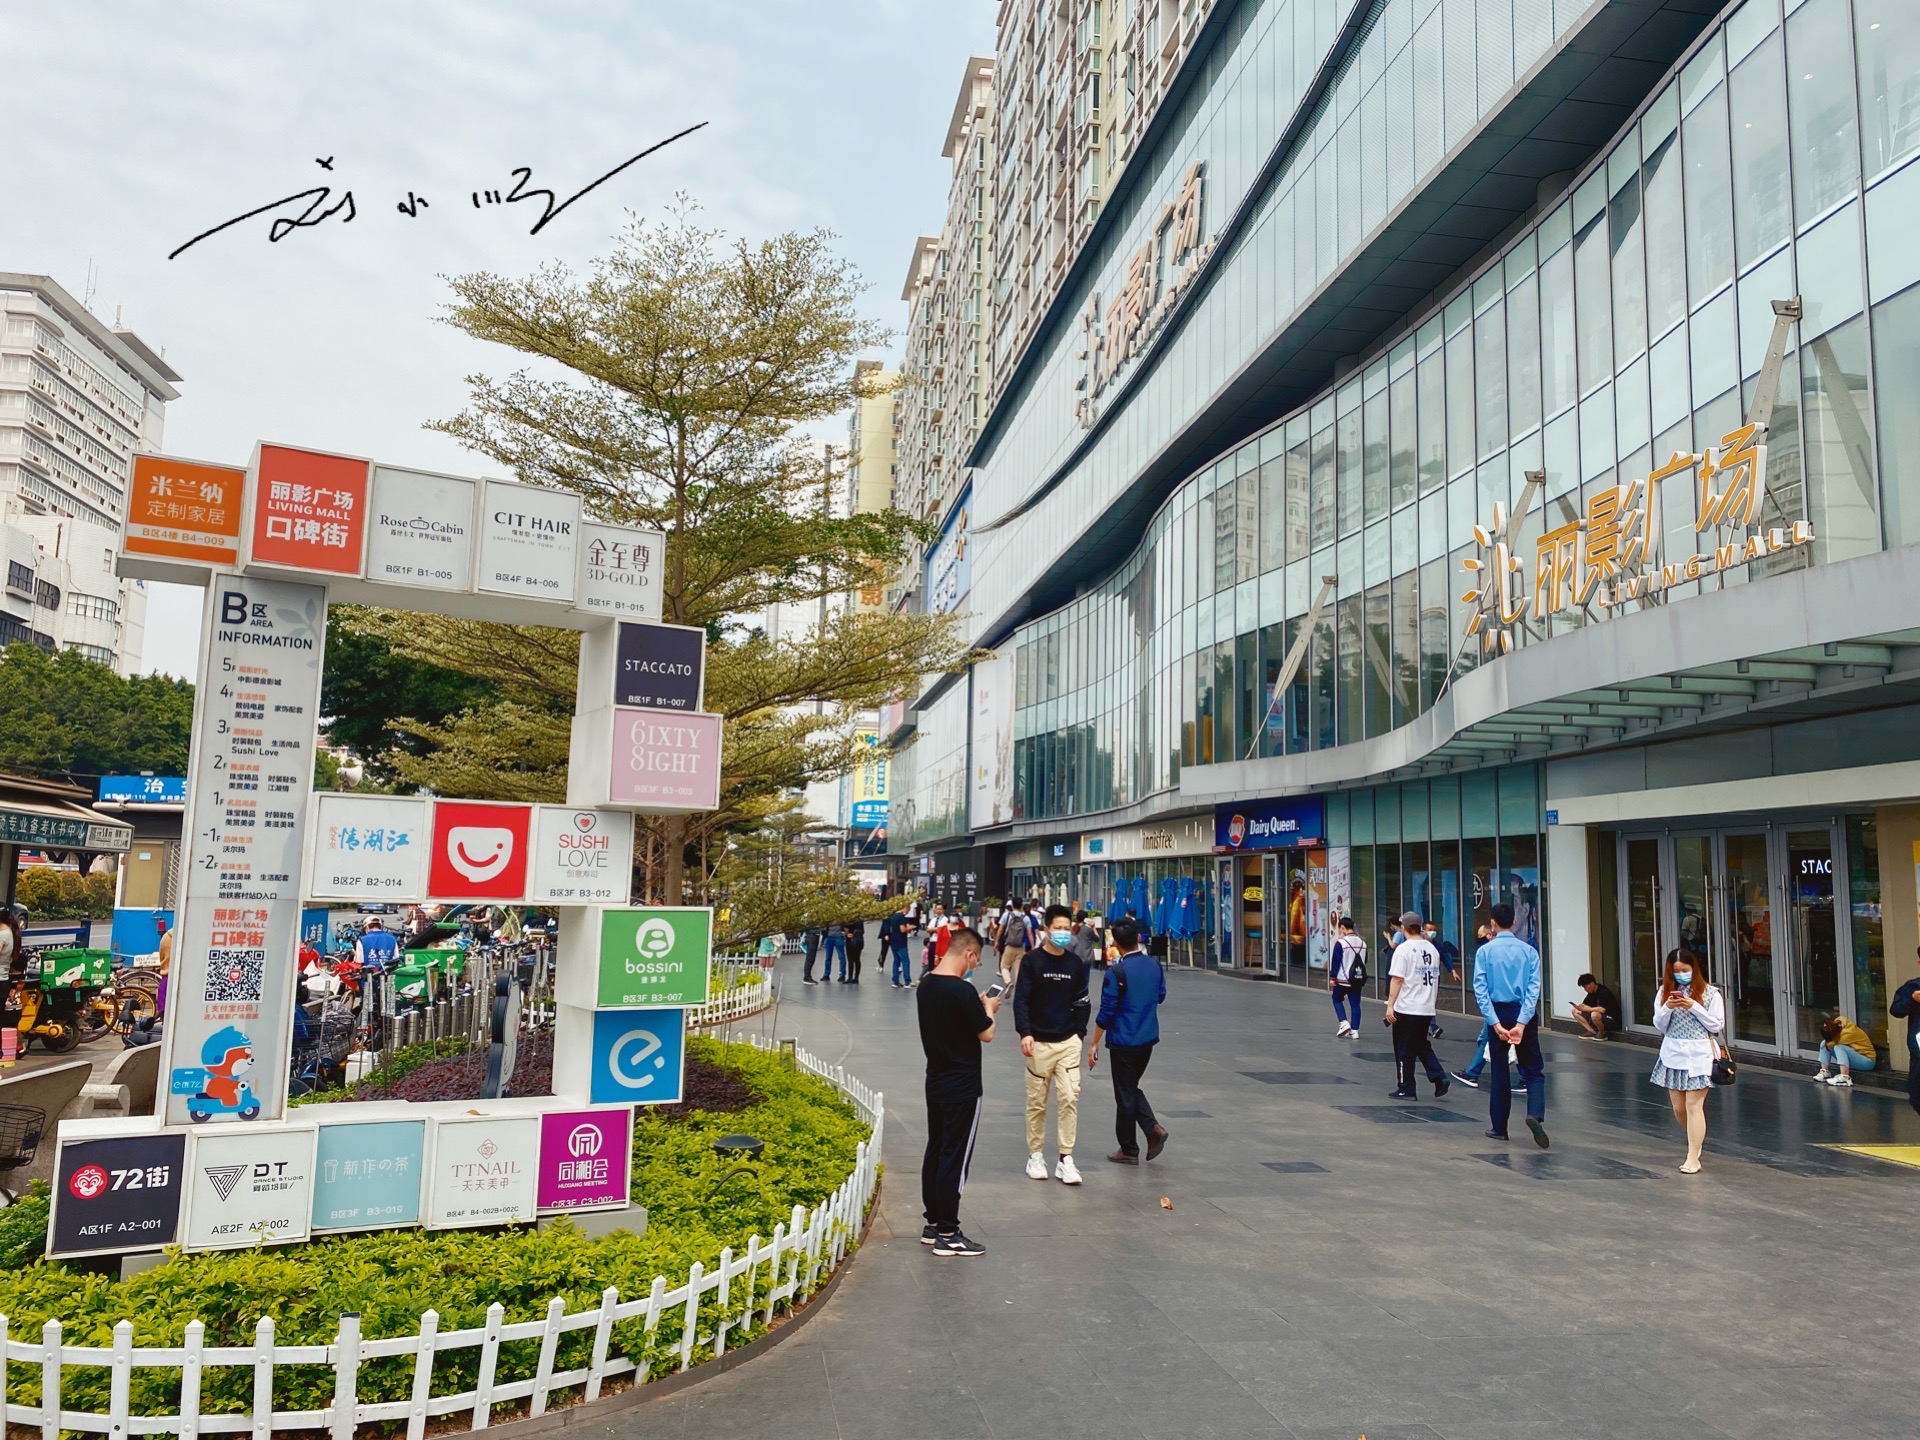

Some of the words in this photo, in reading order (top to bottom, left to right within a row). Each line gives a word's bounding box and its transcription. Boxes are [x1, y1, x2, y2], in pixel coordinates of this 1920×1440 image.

[149, 475, 224, 504] 米兰纳
[269, 480, 355, 511] 丽影广场
[146, 500, 226, 526] 定制家居
[267, 500, 313, 516] LIVING
[316, 508, 351, 521] MALL
[379, 513, 408, 529] Rose
[430, 520, 463, 536] Cabin
[494, 511, 525, 527] CIT
[531, 517, 571, 535] HAIR
[142, 528, 178, 541] B区4楼
[181, 532, 225, 546] B4-009
[265, 516, 349, 548] 口碑街
[587, 537, 651, 572] 金至尊
[385, 564, 412, 575] B区1F
[417, 568, 453, 580] B1-005
[1597, 554, 1710, 608] LIVING
[1714, 520, 1815, 571] MALL
[494, 571, 521, 583] B区4F
[526, 576, 560, 589] B4-006
[586, 567, 649, 587] 3D-GOLD
[587, 597, 611, 608] B区1F
[615, 600, 644, 612] B1-015
[250, 619, 273, 628] AREA
[218, 630, 313, 650] INFORMATION
[222, 657, 236, 672] 5F
[624, 658, 692, 677] STACCATO
[220, 684, 234, 698] 4F
[628, 694, 652, 705] B区1F
[656, 696, 686, 707] B1-007
[217, 719, 230, 734] 3F
[630, 719, 703, 749] 6IXTY
[231, 746, 256, 756] Sushi
[259, 748, 279, 757] Love
[630, 745, 701, 774] 8IGHT
[213, 755, 228, 769] 2F
[213, 791, 224, 805] 1F
[634, 784, 659, 794] B区3F
[662, 785, 693, 796] B3-003
[1249, 819, 1270, 837] Dairy
[1270, 816, 1296, 835] Queen
[558, 834, 609, 850] SUSHI
[1142, 829, 1174, 850] innisfree
[222, 845, 246, 853] 沃尔玛
[558, 850, 609, 868] LOVE
[332, 876, 362, 887] B区2F
[366, 877, 403, 887] B2-014
[566, 869, 599, 879] 创意寿司
[219, 882, 242, 890] 沃尔玛
[549, 888, 576, 898] B区3F
[579, 888, 612, 898] B3-012
[214, 908, 269, 922] 丽影广场
[212, 921, 242, 929] LIVING
[211, 930, 265, 948] 口碑街
[625, 957, 683, 975] bossini
[622, 994, 648, 1003] B区3F
[651, 993, 683, 1002] B3-007
[254, 1161, 289, 1177] DT
[343, 1156, 410, 1175] 新作の茶
[451, 1161, 522, 1178] TTNAIL
[110, 1165, 170, 1191] 72街
[558, 1182, 584, 1190] HUXIANG
[583, 1179, 608, 1188] MEETING
[551, 1198, 577, 1208] C区3F
[580, 1195, 614, 1206] C3-002
[330, 1208, 360, 1219] B区3F
[366, 1205, 403, 1216] B3-019
[446, 1209, 467, 1218] B区4F
[78, 1223, 113, 1236] A区1F
[117, 1219, 161, 1232] A2-001
[211, 1223, 244, 1235] A区2F
[248, 1219, 290, 1232] A2-002
